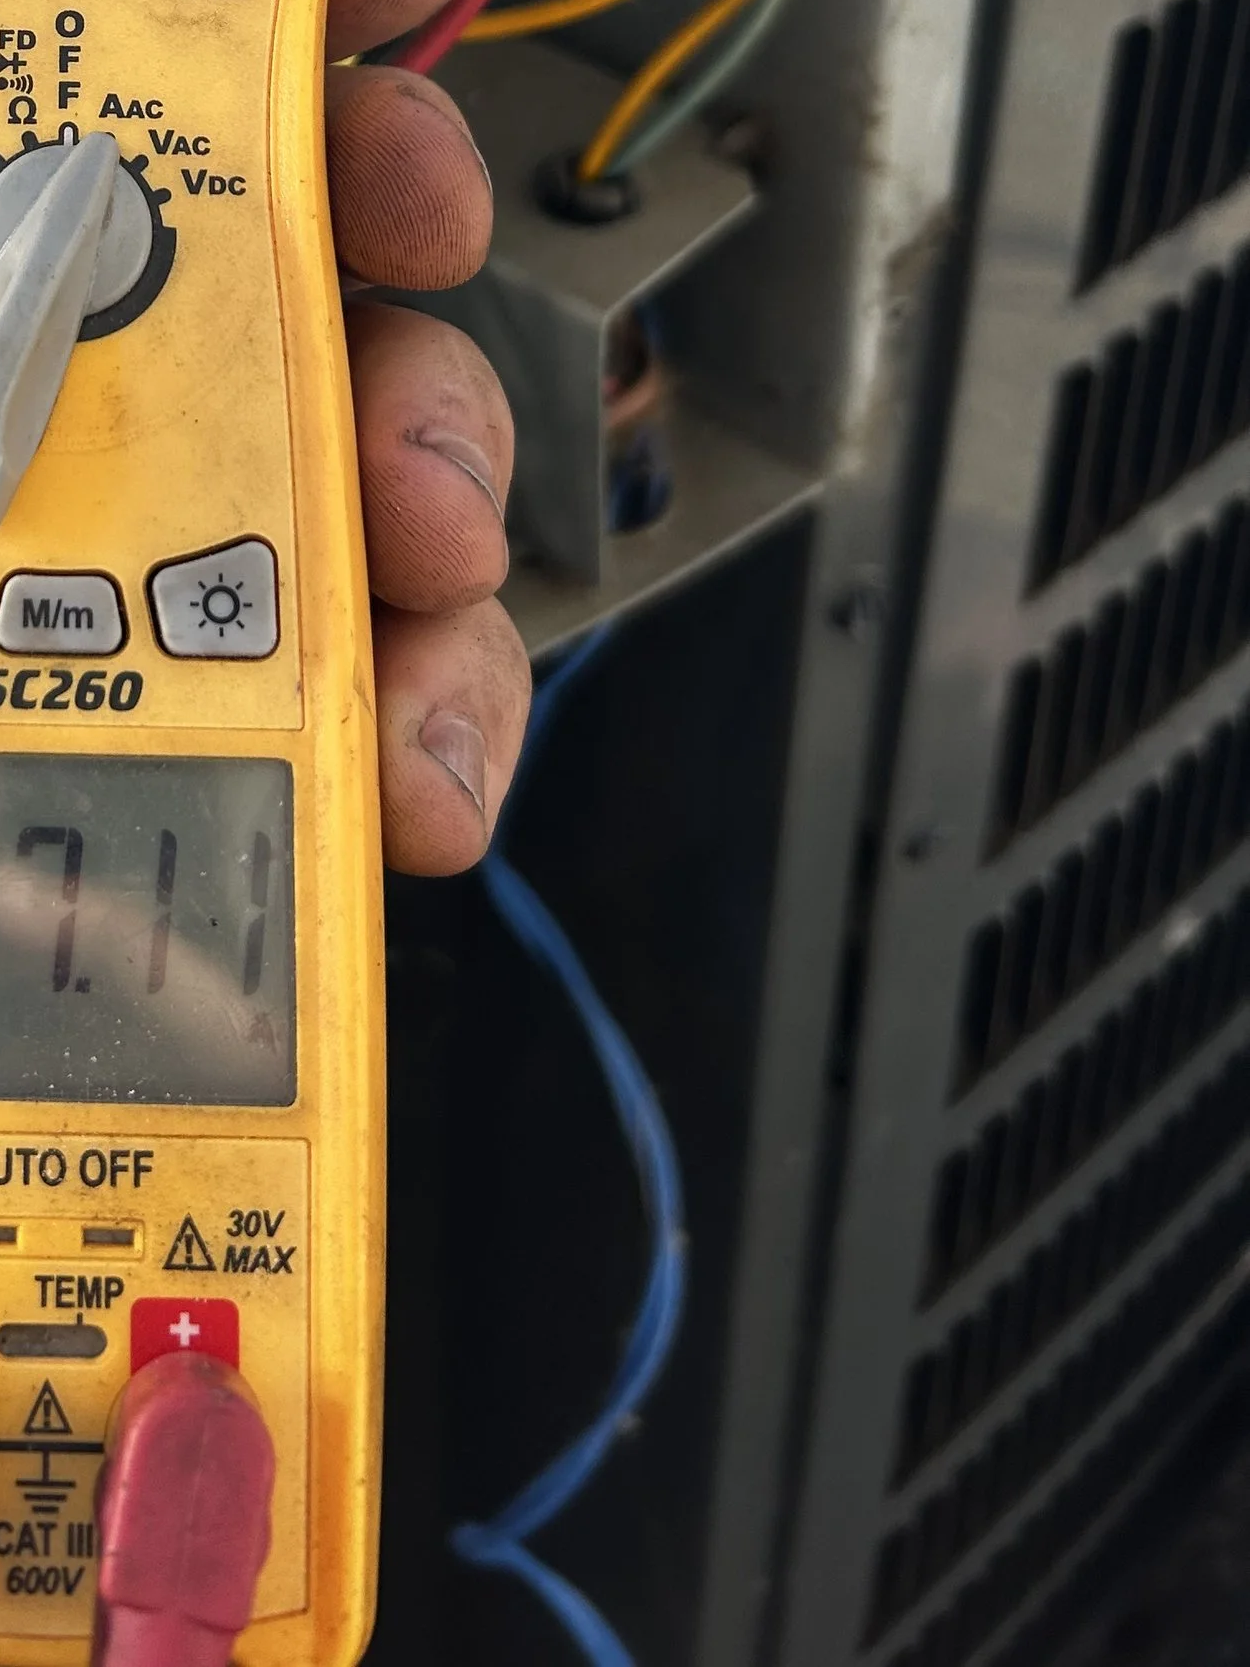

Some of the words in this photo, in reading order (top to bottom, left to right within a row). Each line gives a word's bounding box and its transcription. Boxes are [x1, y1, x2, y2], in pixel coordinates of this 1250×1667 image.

[21, 597, 95, 631] M/m
[79, 1149, 154, 1188] OFF
[226, 1209, 285, 1238] 30V
[223, 1245, 296, 1274] MAX
[35, 1275, 125, 1309] TEMP
[6, 1565, 86, 1596] 600V
